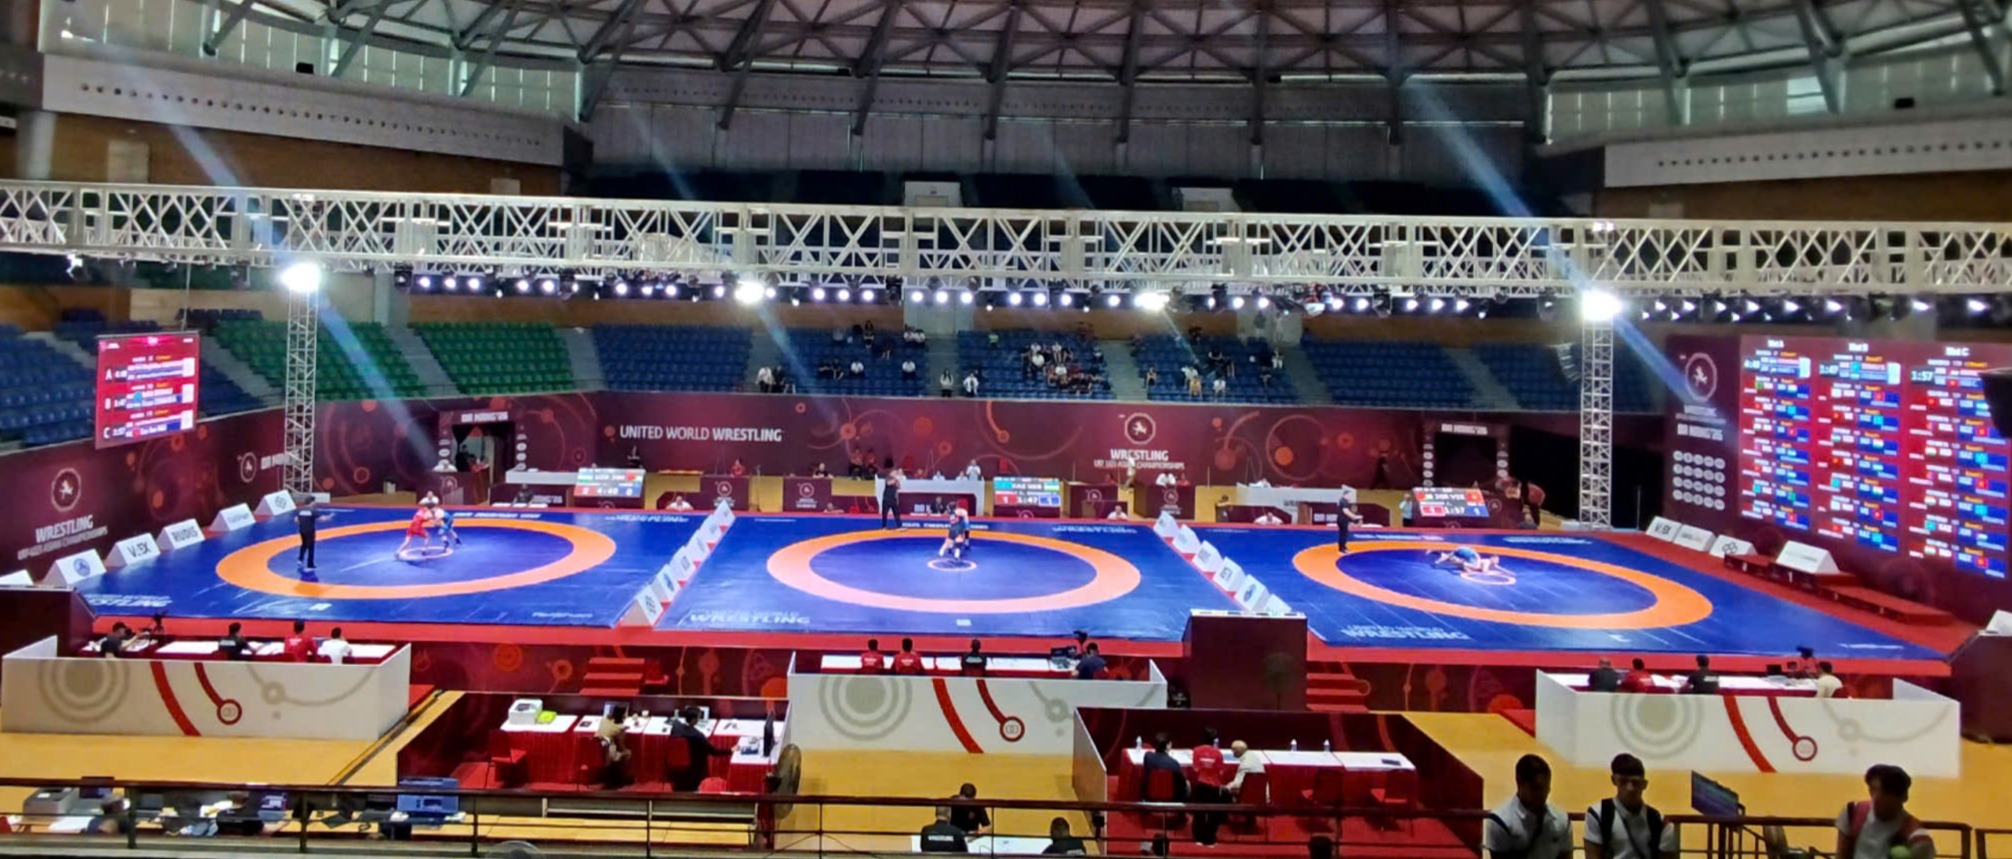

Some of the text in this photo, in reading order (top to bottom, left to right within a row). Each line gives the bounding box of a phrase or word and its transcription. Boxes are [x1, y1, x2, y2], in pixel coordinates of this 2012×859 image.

[105, 368, 113, 381] A
[1911, 370, 1934, 382] 1:57
[103, 426, 111, 439] C
[620, 425, 782, 442] UNITED WORLD WRESTLING
[1110, 448, 1169, 461] WRESTLING
[35, 514, 94, 544] WRESTLING
